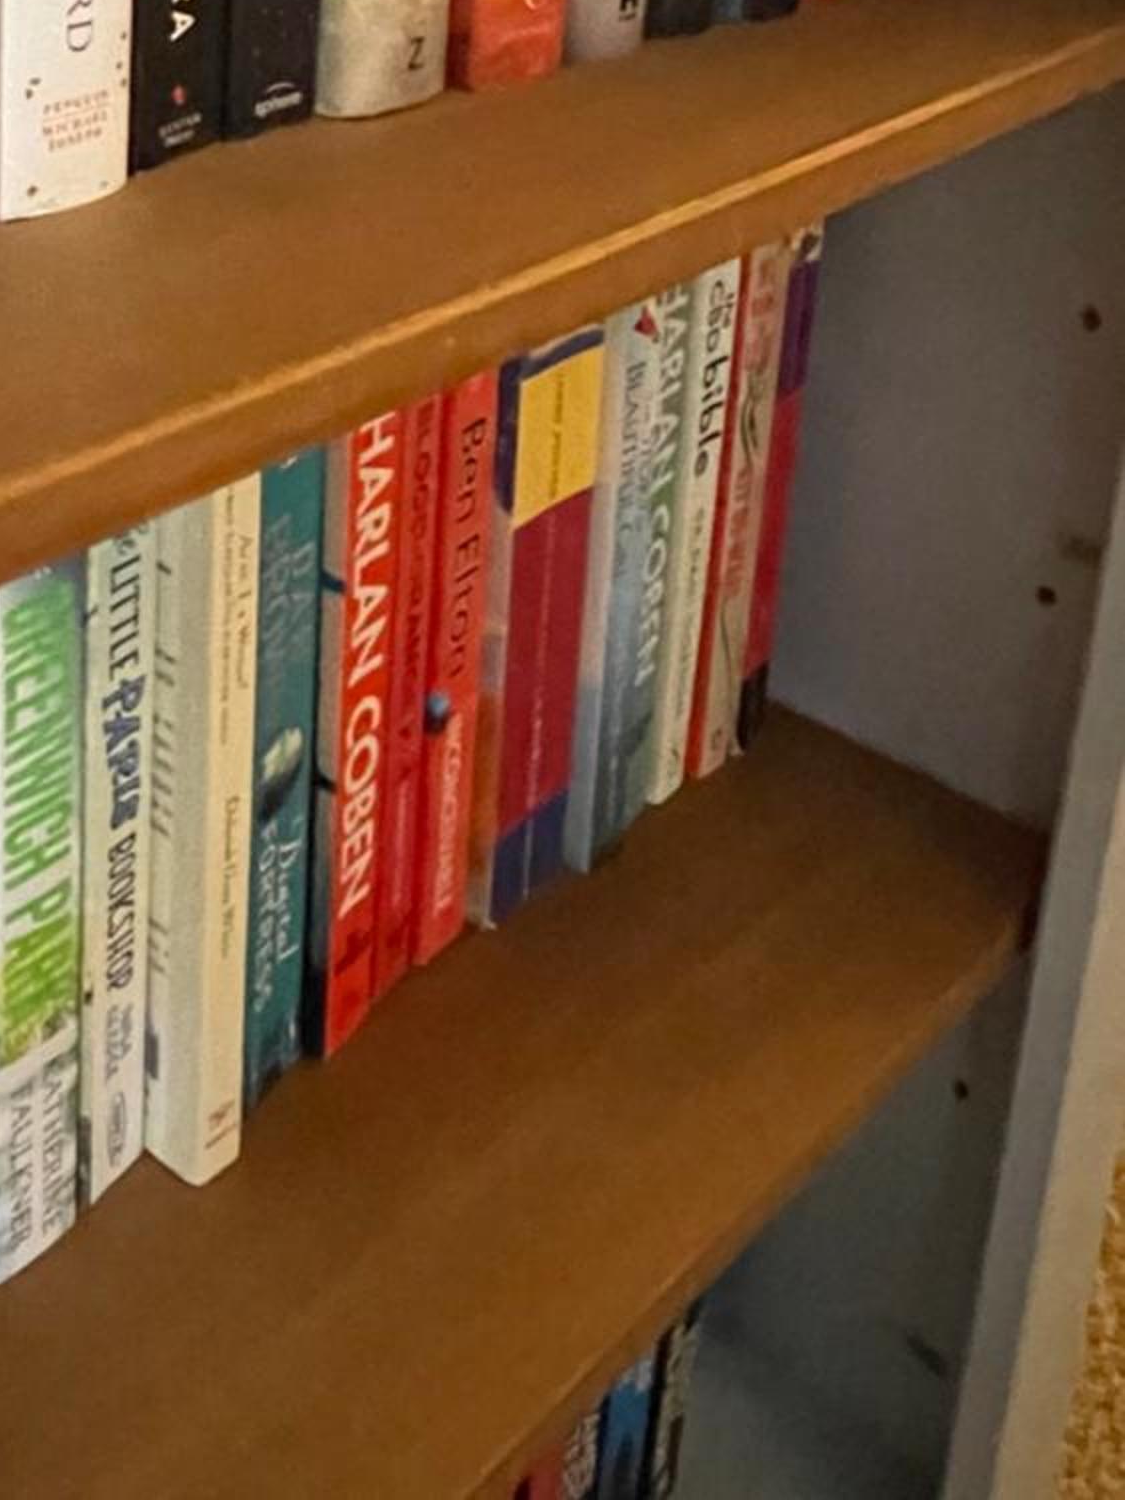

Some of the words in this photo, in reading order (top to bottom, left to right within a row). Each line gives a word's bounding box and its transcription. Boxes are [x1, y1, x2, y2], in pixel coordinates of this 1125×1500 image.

[454, 416, 489, 526] Ben
[694, 354, 729, 478] bible
[107, 554, 145, 674] LITTLE
[347, 412, 398, 689] HARLAN
[446, 532, 483, 680] Elton
[633, 503, 671, 687] COBEN
[2, 590, 77, 890] GREENWICH
[102, 674, 146, 829] PARIS
[336, 693, 383, 920] COBEN
[104, 830, 138, 993] BOOKSHOP
